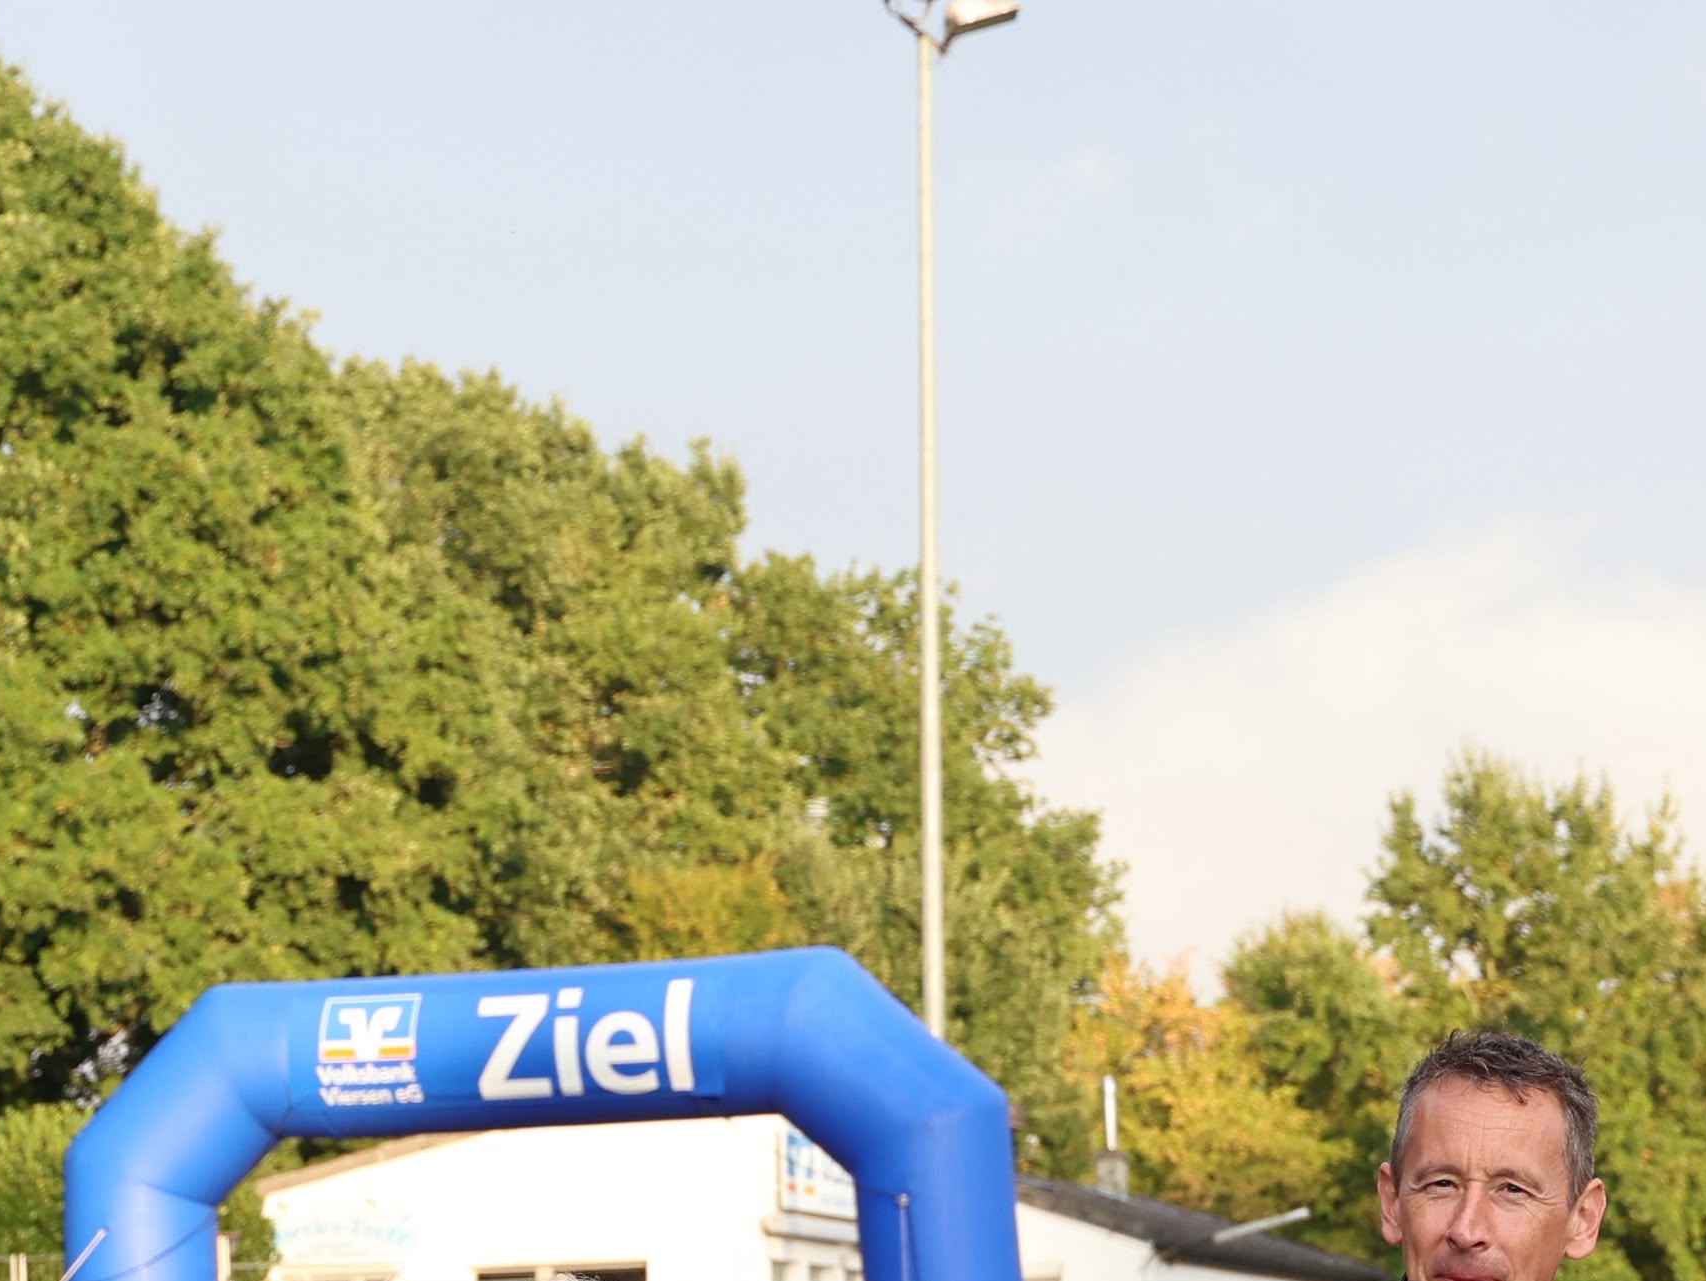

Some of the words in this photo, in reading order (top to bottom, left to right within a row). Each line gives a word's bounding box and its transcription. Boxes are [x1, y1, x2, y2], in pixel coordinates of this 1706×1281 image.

[477, 978, 694, 1100] Ziel
[316, 1060, 416, 1087] Volksbank
[319, 1086, 393, 1107] Viersen
[394, 1084, 424, 1104] eG
